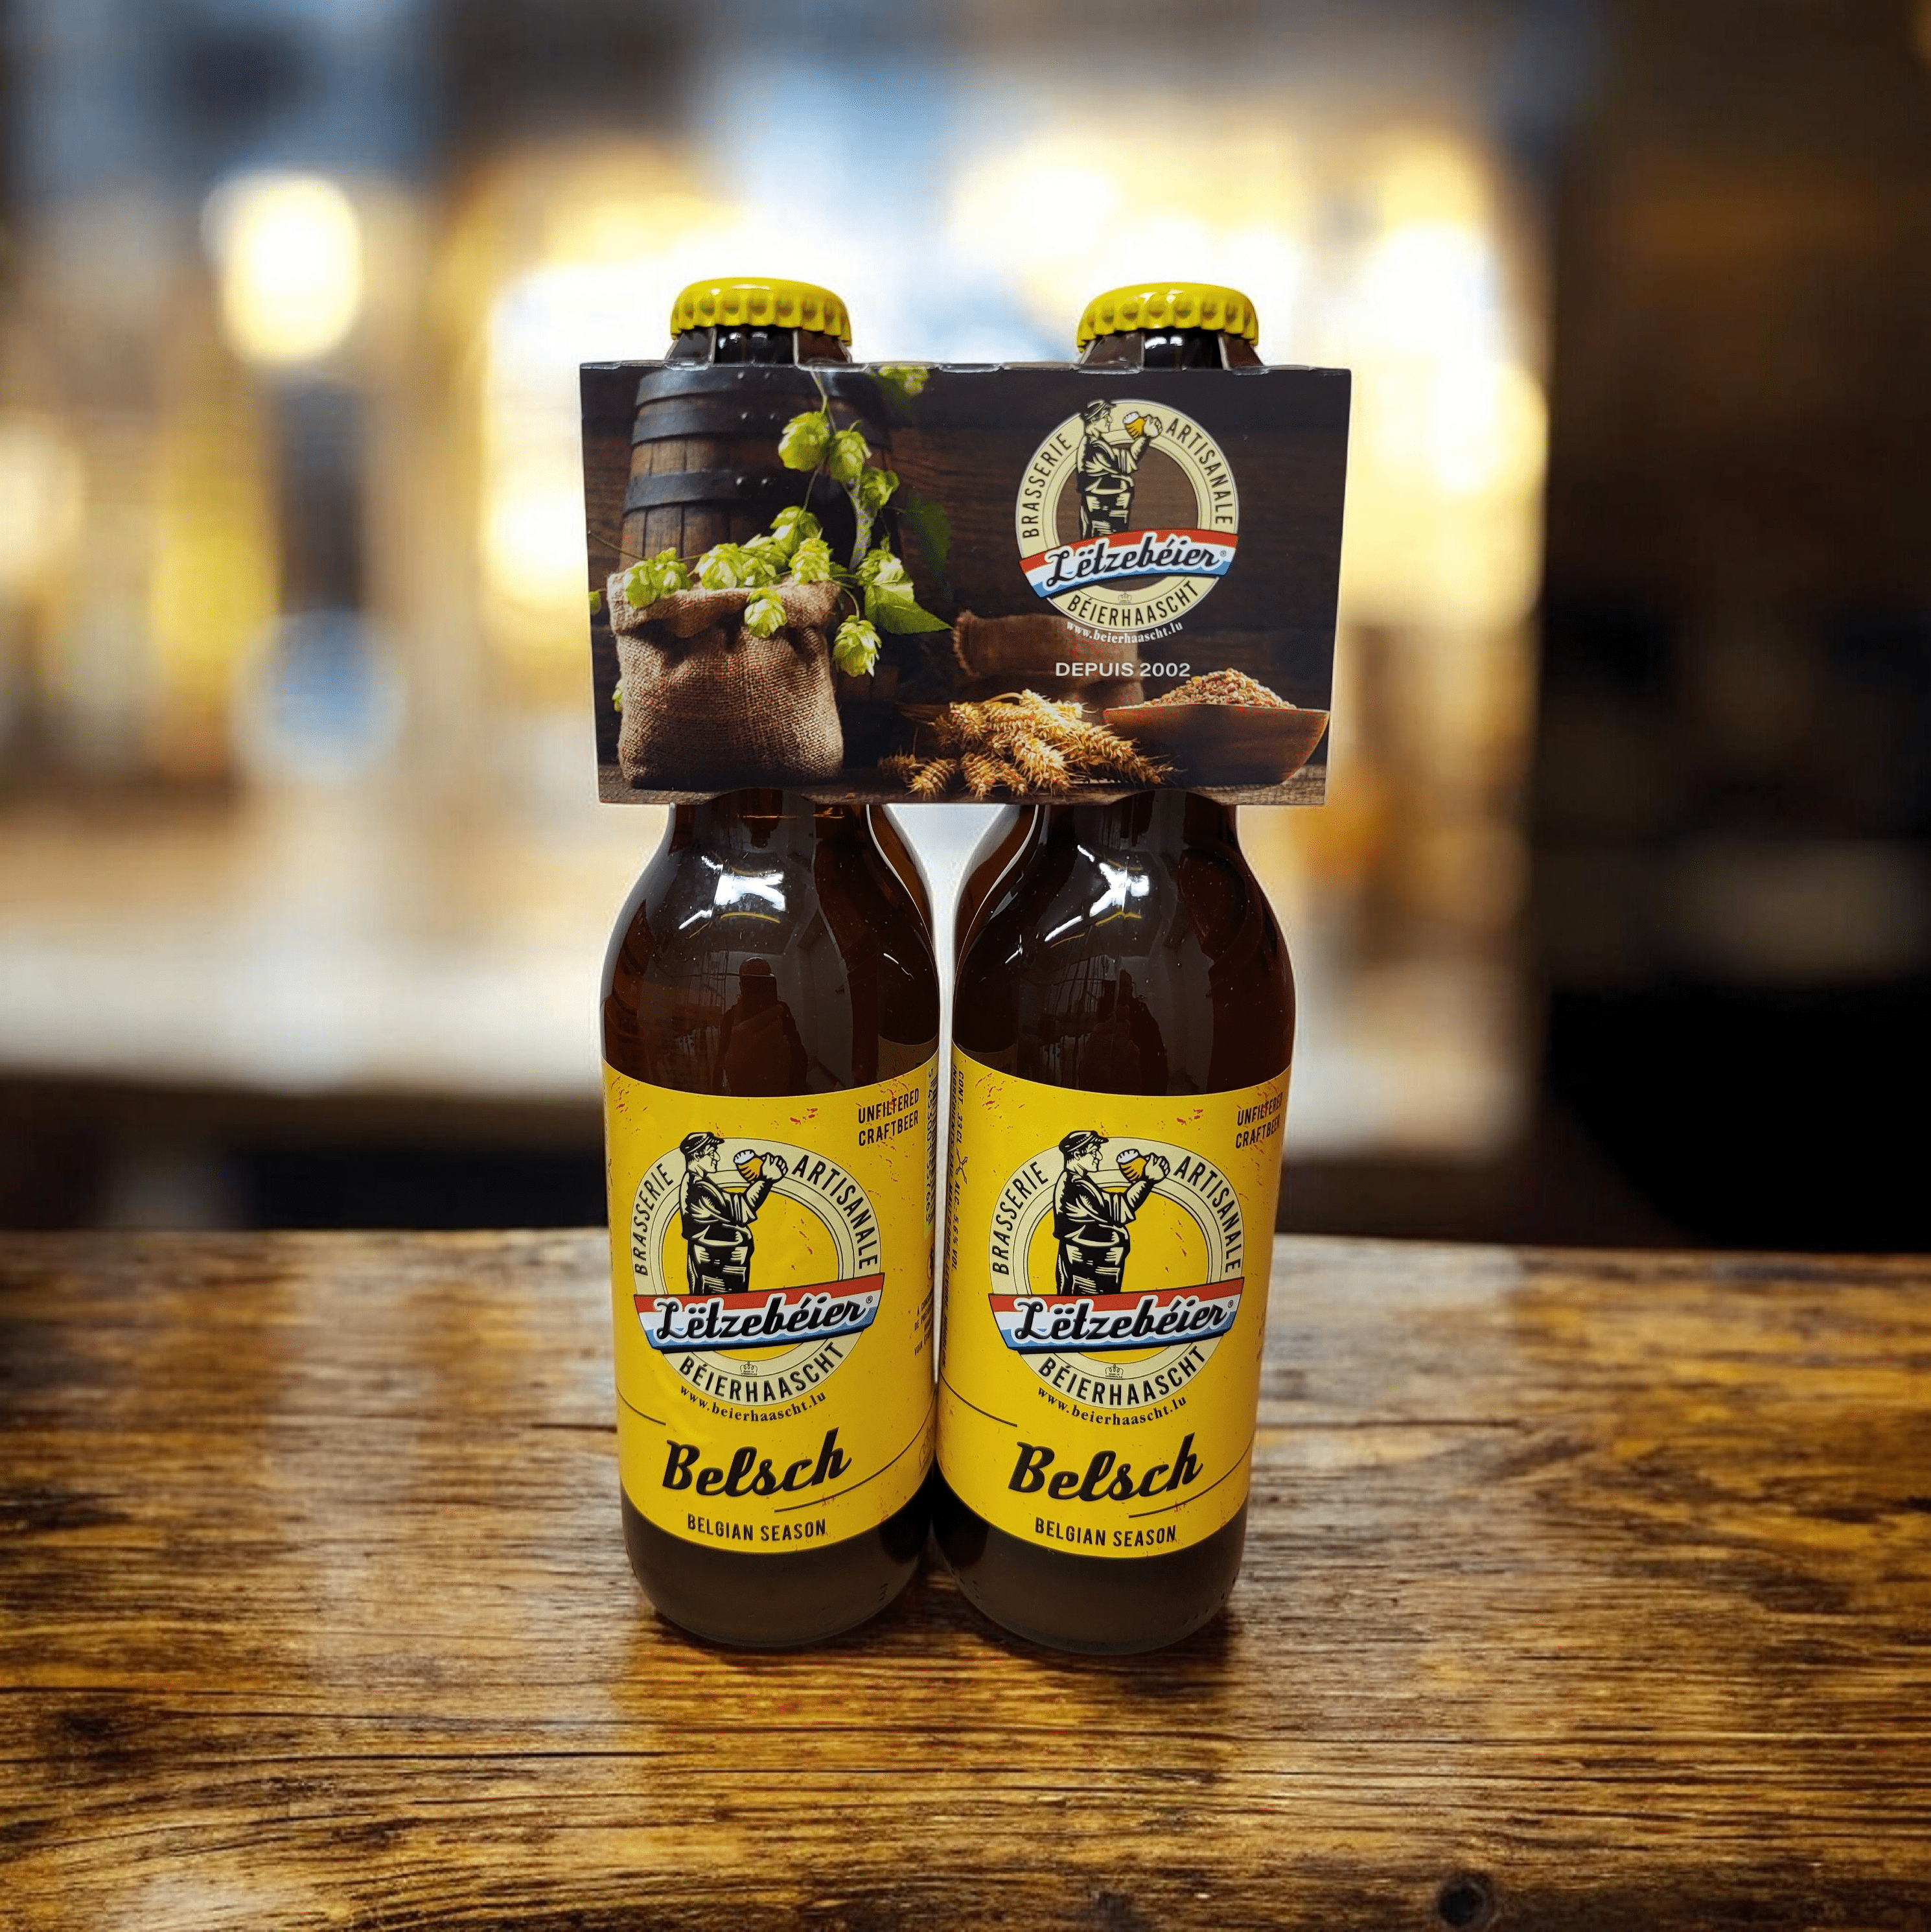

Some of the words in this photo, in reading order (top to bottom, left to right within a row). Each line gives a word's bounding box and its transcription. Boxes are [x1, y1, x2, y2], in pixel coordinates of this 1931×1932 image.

[1021, 432, 1072, 539] BRASSERIE
[1166, 417, 1234, 526] ARTISANALE
[1067, 580, 1199, 627] BÉIERHAASCHT
[1067, 620, 1183, 644] www.beierhaascht.lu
[1056, 662, 1134, 677] DEPUIS
[1139, 662, 1191, 677] 2002
[858, 1088, 919, 1124] UNFILTERED
[858, 1109, 919, 1146] CRAFTBEER
[1237, 1092, 1284, 1126] UNFILTERED
[1236, 1113, 1280, 1149] CRAFTBEER
[634, 1163, 674, 1275] BRASSERIE
[792, 1155, 878, 1270] ARTISANALE
[991, 1161, 1048, 1275] BRASSERIE
[1174, 1156, 1240, 1274] ARTISANALE
[680, 1342, 845, 1404] BÉIERHAASCHT
[1038, 1346, 1207, 1406] BÉIERHAASCHT
[680, 1385, 826, 1422] www.beierhaascht.lu
[1038, 1386, 1186, 1426] www.beierhaascht.lu
[662, 1426, 852, 1496] Belsch
[1008, 1432, 1203, 1502] Belsch
[688, 1513, 754, 1541] BELGIAN
[760, 1519, 826, 1542] SEASON
[1035, 1517, 1105, 1546] BELGIAN
[1113, 1525, 1176, 1547] SEASON
